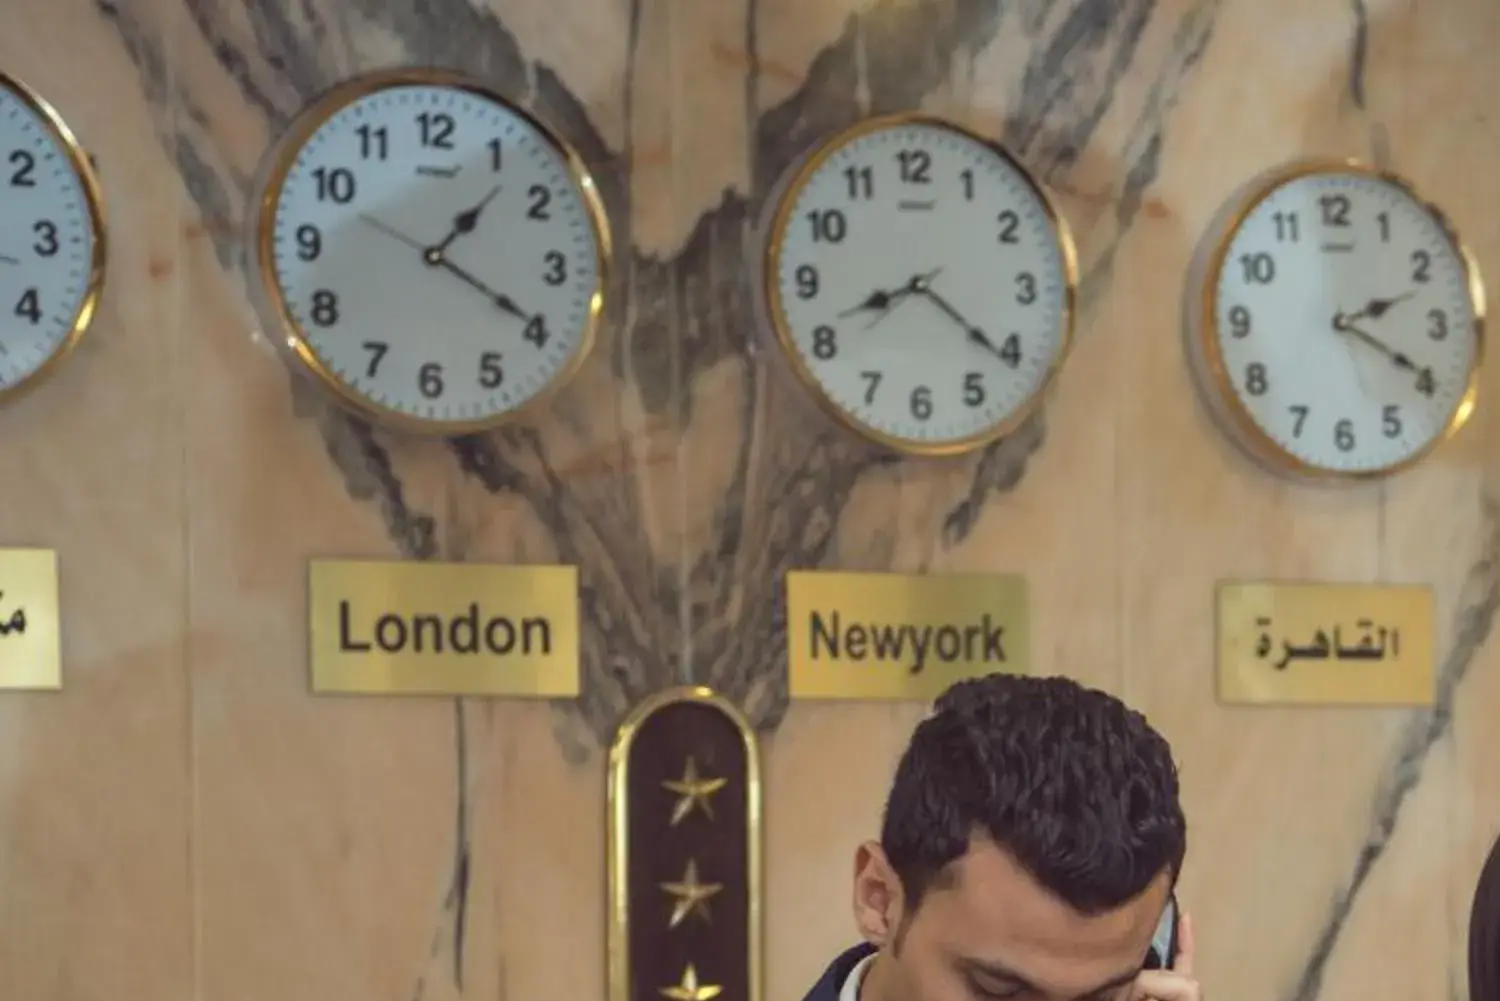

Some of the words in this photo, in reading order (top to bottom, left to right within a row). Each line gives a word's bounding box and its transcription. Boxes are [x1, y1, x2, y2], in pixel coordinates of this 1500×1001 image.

[355, 123, 388, 161] 11
[414, 112, 456, 150] 12
[8, 148, 37, 188] 2
[488, 137, 502, 173] 1
[895, 149, 932, 184] 12
[310, 166, 357, 205] 10
[843, 165, 875, 200] 11
[960, 168, 975, 201] 1
[526, 184, 552, 222] 2
[1318, 194, 1351, 227] 12
[33, 219, 60, 258] 3
[295, 223, 322, 262] 9
[806, 208, 847, 244] 10
[997, 209, 1020, 245] 2
[1271, 211, 1299, 243] 11
[1377, 212, 1391, 243] 1
[543, 250, 568, 287] 3
[794, 264, 820, 301] 9
[1239, 252, 1276, 285] 10
[1411, 249, 1431, 284] 2
[14, 287, 43, 326] 4
[1015, 272, 1037, 306] 3
[310, 289, 340, 328] 8
[1228, 305, 1251, 339] 9
[1428, 309, 1448, 341] 3
[523, 314, 548, 350] 4
[812, 324, 838, 361] 8
[362, 341, 389, 378] 7
[1001, 333, 1022, 368] 4
[418, 362, 444, 399] 6
[478, 351, 504, 390] 5
[860, 371, 883, 405] 7
[1245, 362, 1269, 397] 8
[1414, 366, 1435, 399] 4
[909, 385, 933, 421] 6
[963, 372, 986, 408] 5
[1288, 405, 1310, 439] 7
[1334, 419, 1356, 453] 6
[1382, 405, 1403, 439] 5
[339, 599, 552, 655] London
[809, 609, 1007, 675] Newyork
[1255, 617, 1400, 672] القاهرة
